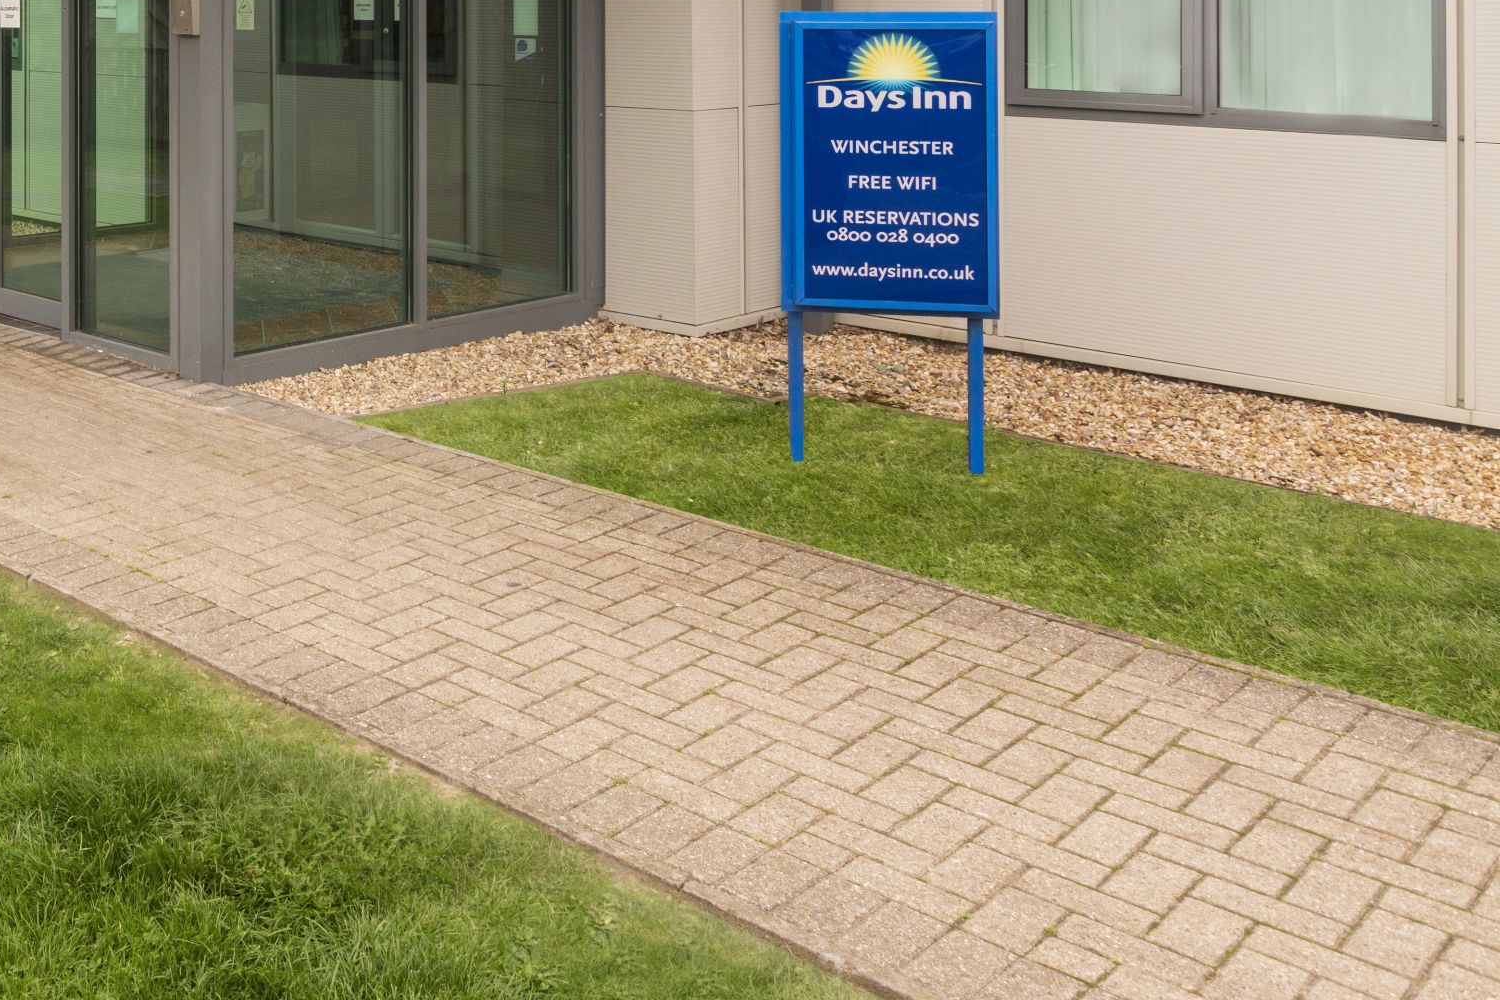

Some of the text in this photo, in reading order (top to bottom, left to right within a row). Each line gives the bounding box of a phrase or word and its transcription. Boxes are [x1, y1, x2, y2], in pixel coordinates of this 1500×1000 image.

[817, 85, 973, 113] Days Inn
[830, 139, 954, 156] WINCHESTER
[848, 174, 937, 191] FREE WIFI
[812, 209, 980, 227] UK RESERVATIONS
[826, 227, 960, 248] 0800 028 0400
[811, 261, 975, 282] www.daysinn.co.uk
